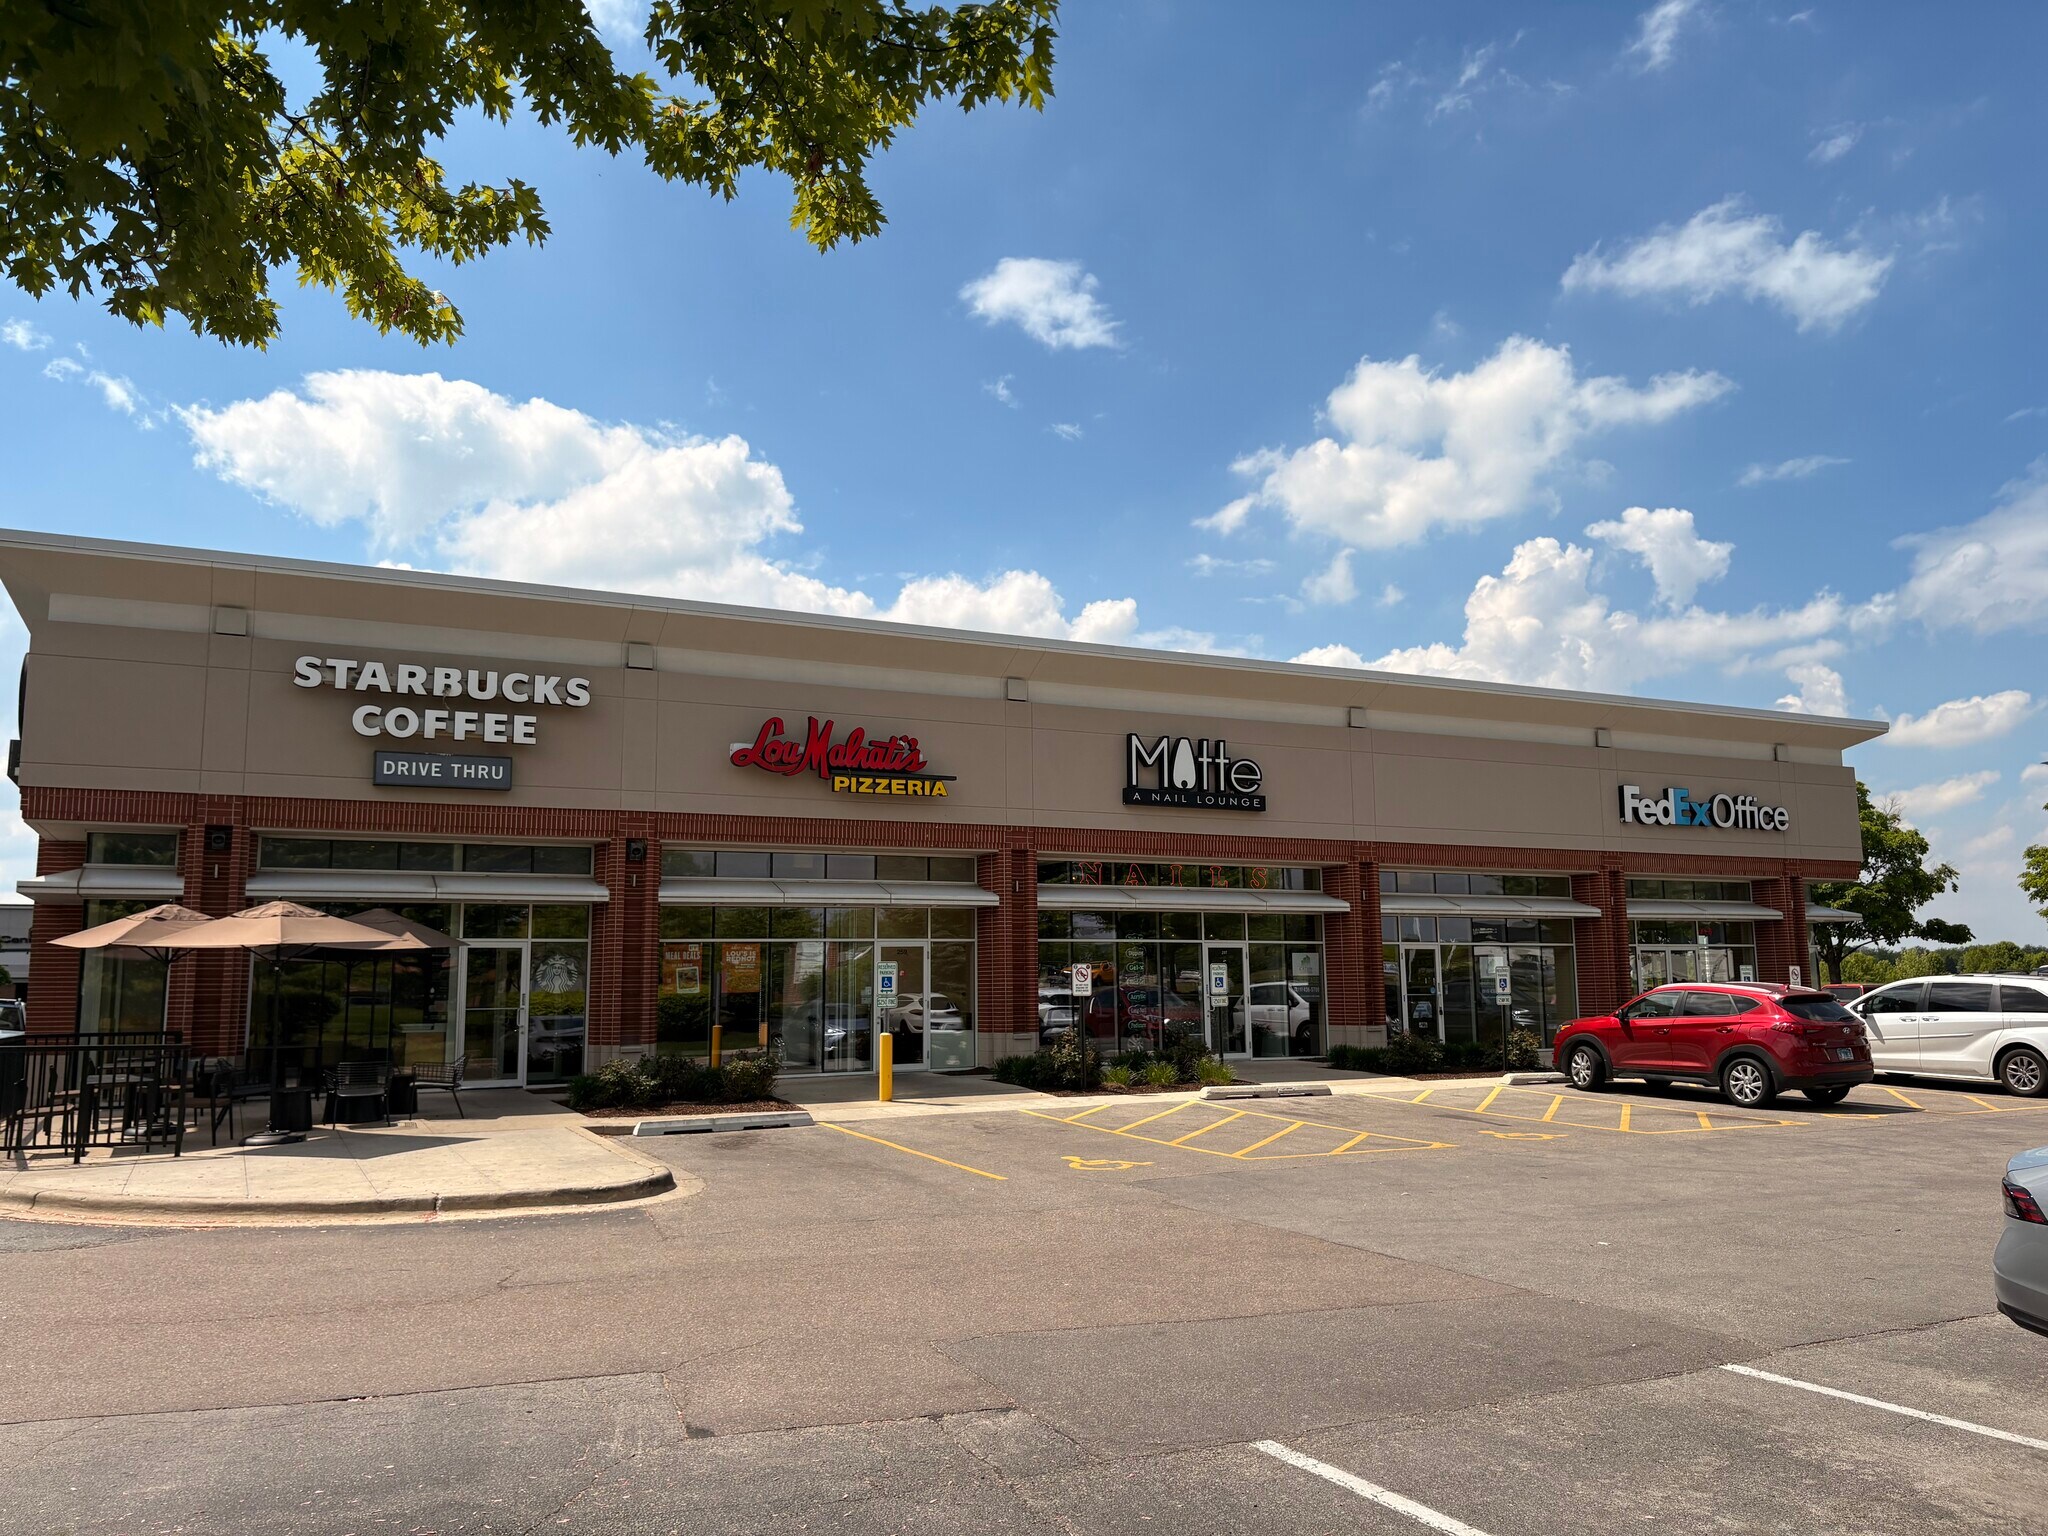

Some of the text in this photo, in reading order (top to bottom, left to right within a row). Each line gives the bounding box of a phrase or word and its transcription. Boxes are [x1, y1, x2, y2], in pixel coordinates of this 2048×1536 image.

[293, 656, 592, 707] STARBUCKS
[351, 705, 537, 745] COFFEE
[730, 716, 927, 779] Lou Malnati's
[383, 760, 504, 779] DRIVE THRU
[833, 776, 949, 797] PIZZERIA
[1133, 792, 1261, 807] A NAIL LOUNGE
[665, 951, 700, 960] MEAL DEALS
